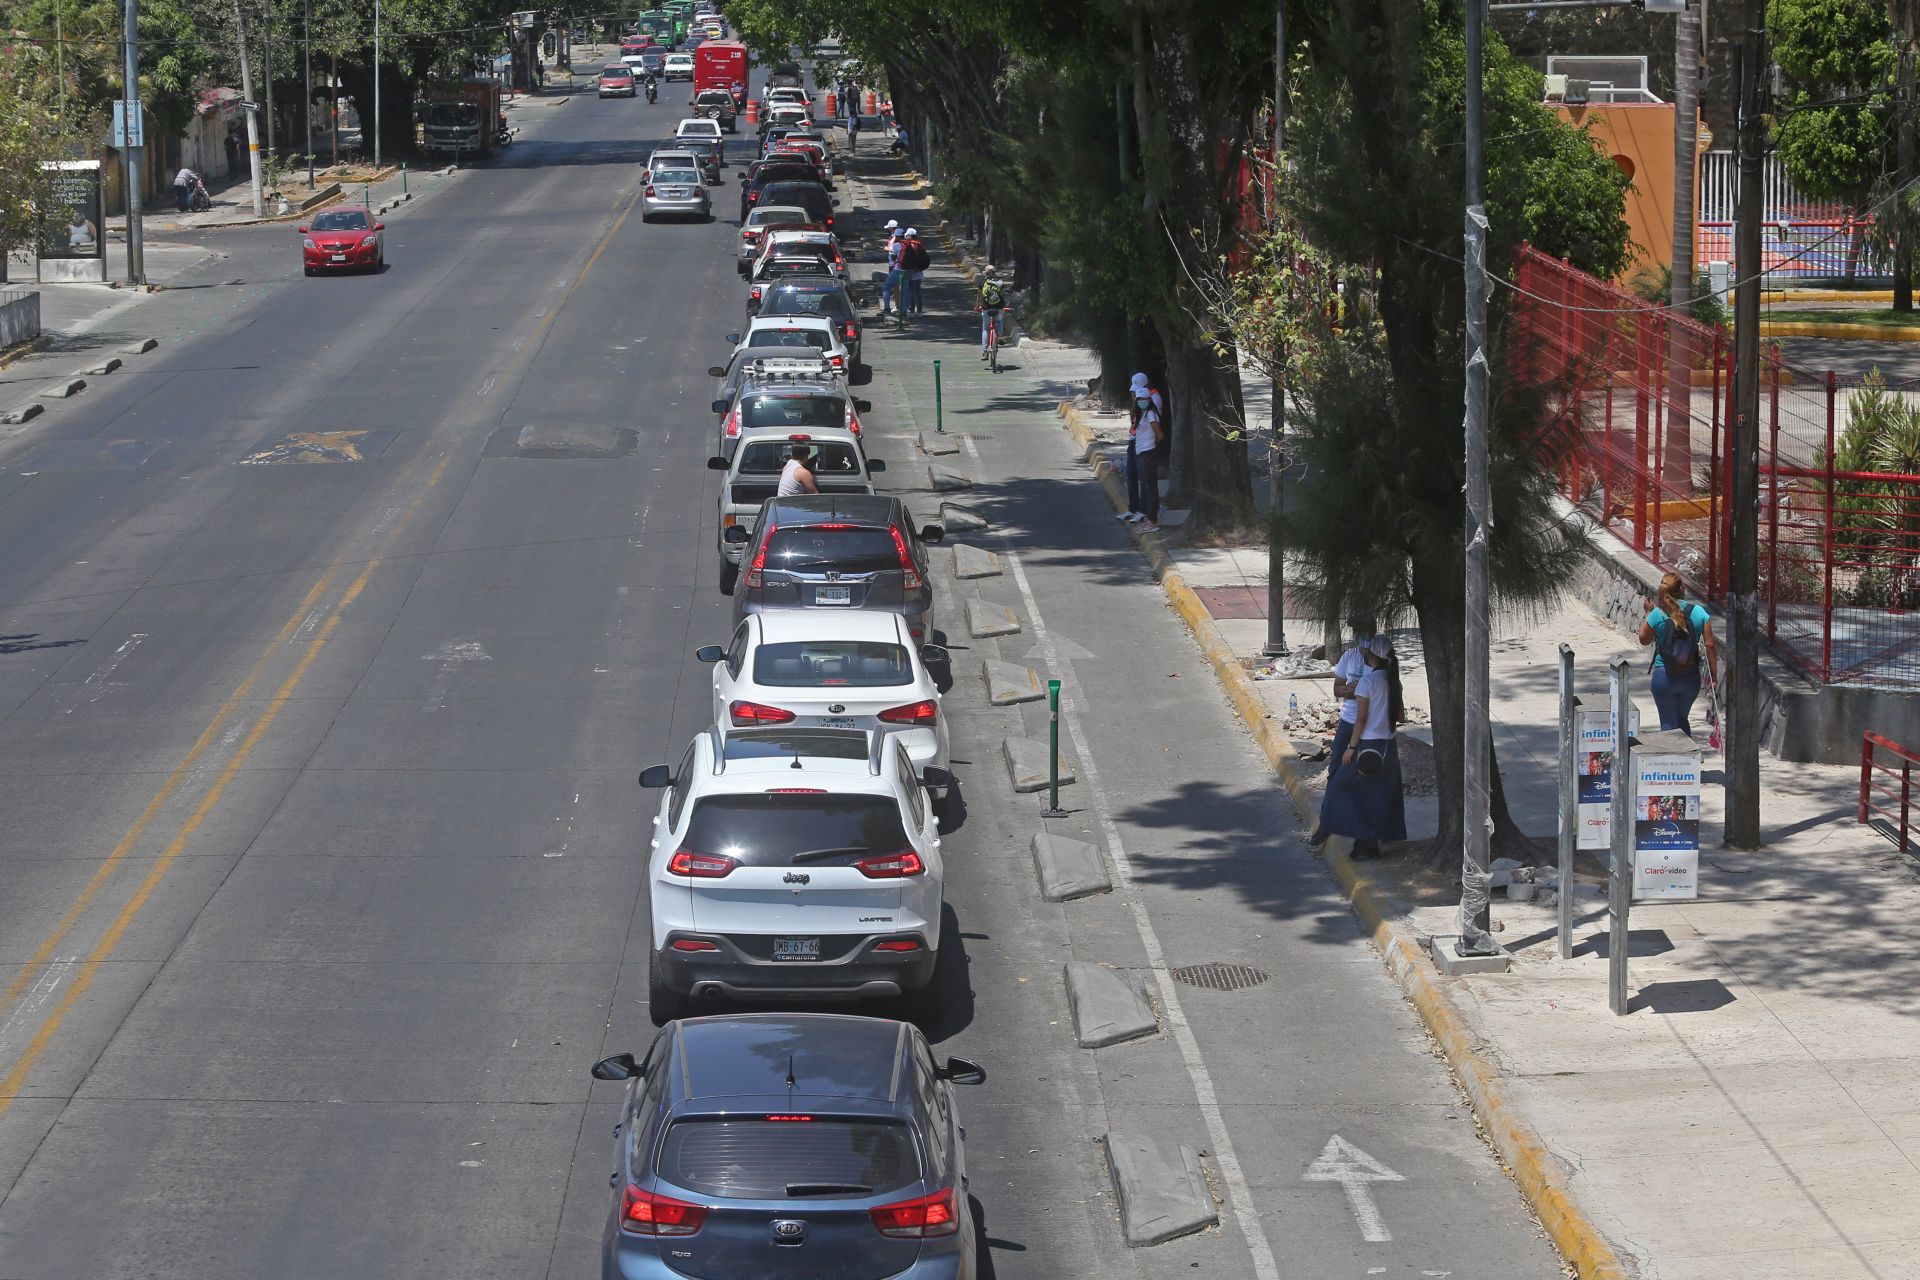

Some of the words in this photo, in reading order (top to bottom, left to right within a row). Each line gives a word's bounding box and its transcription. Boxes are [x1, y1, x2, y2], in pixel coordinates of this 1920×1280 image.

[1641, 771, 1695, 781] infinitum
[783, 872, 811, 885] Jeep
[774, 941, 820, 953] JMB-67-66
[780, 1224, 799, 1233] KIA
